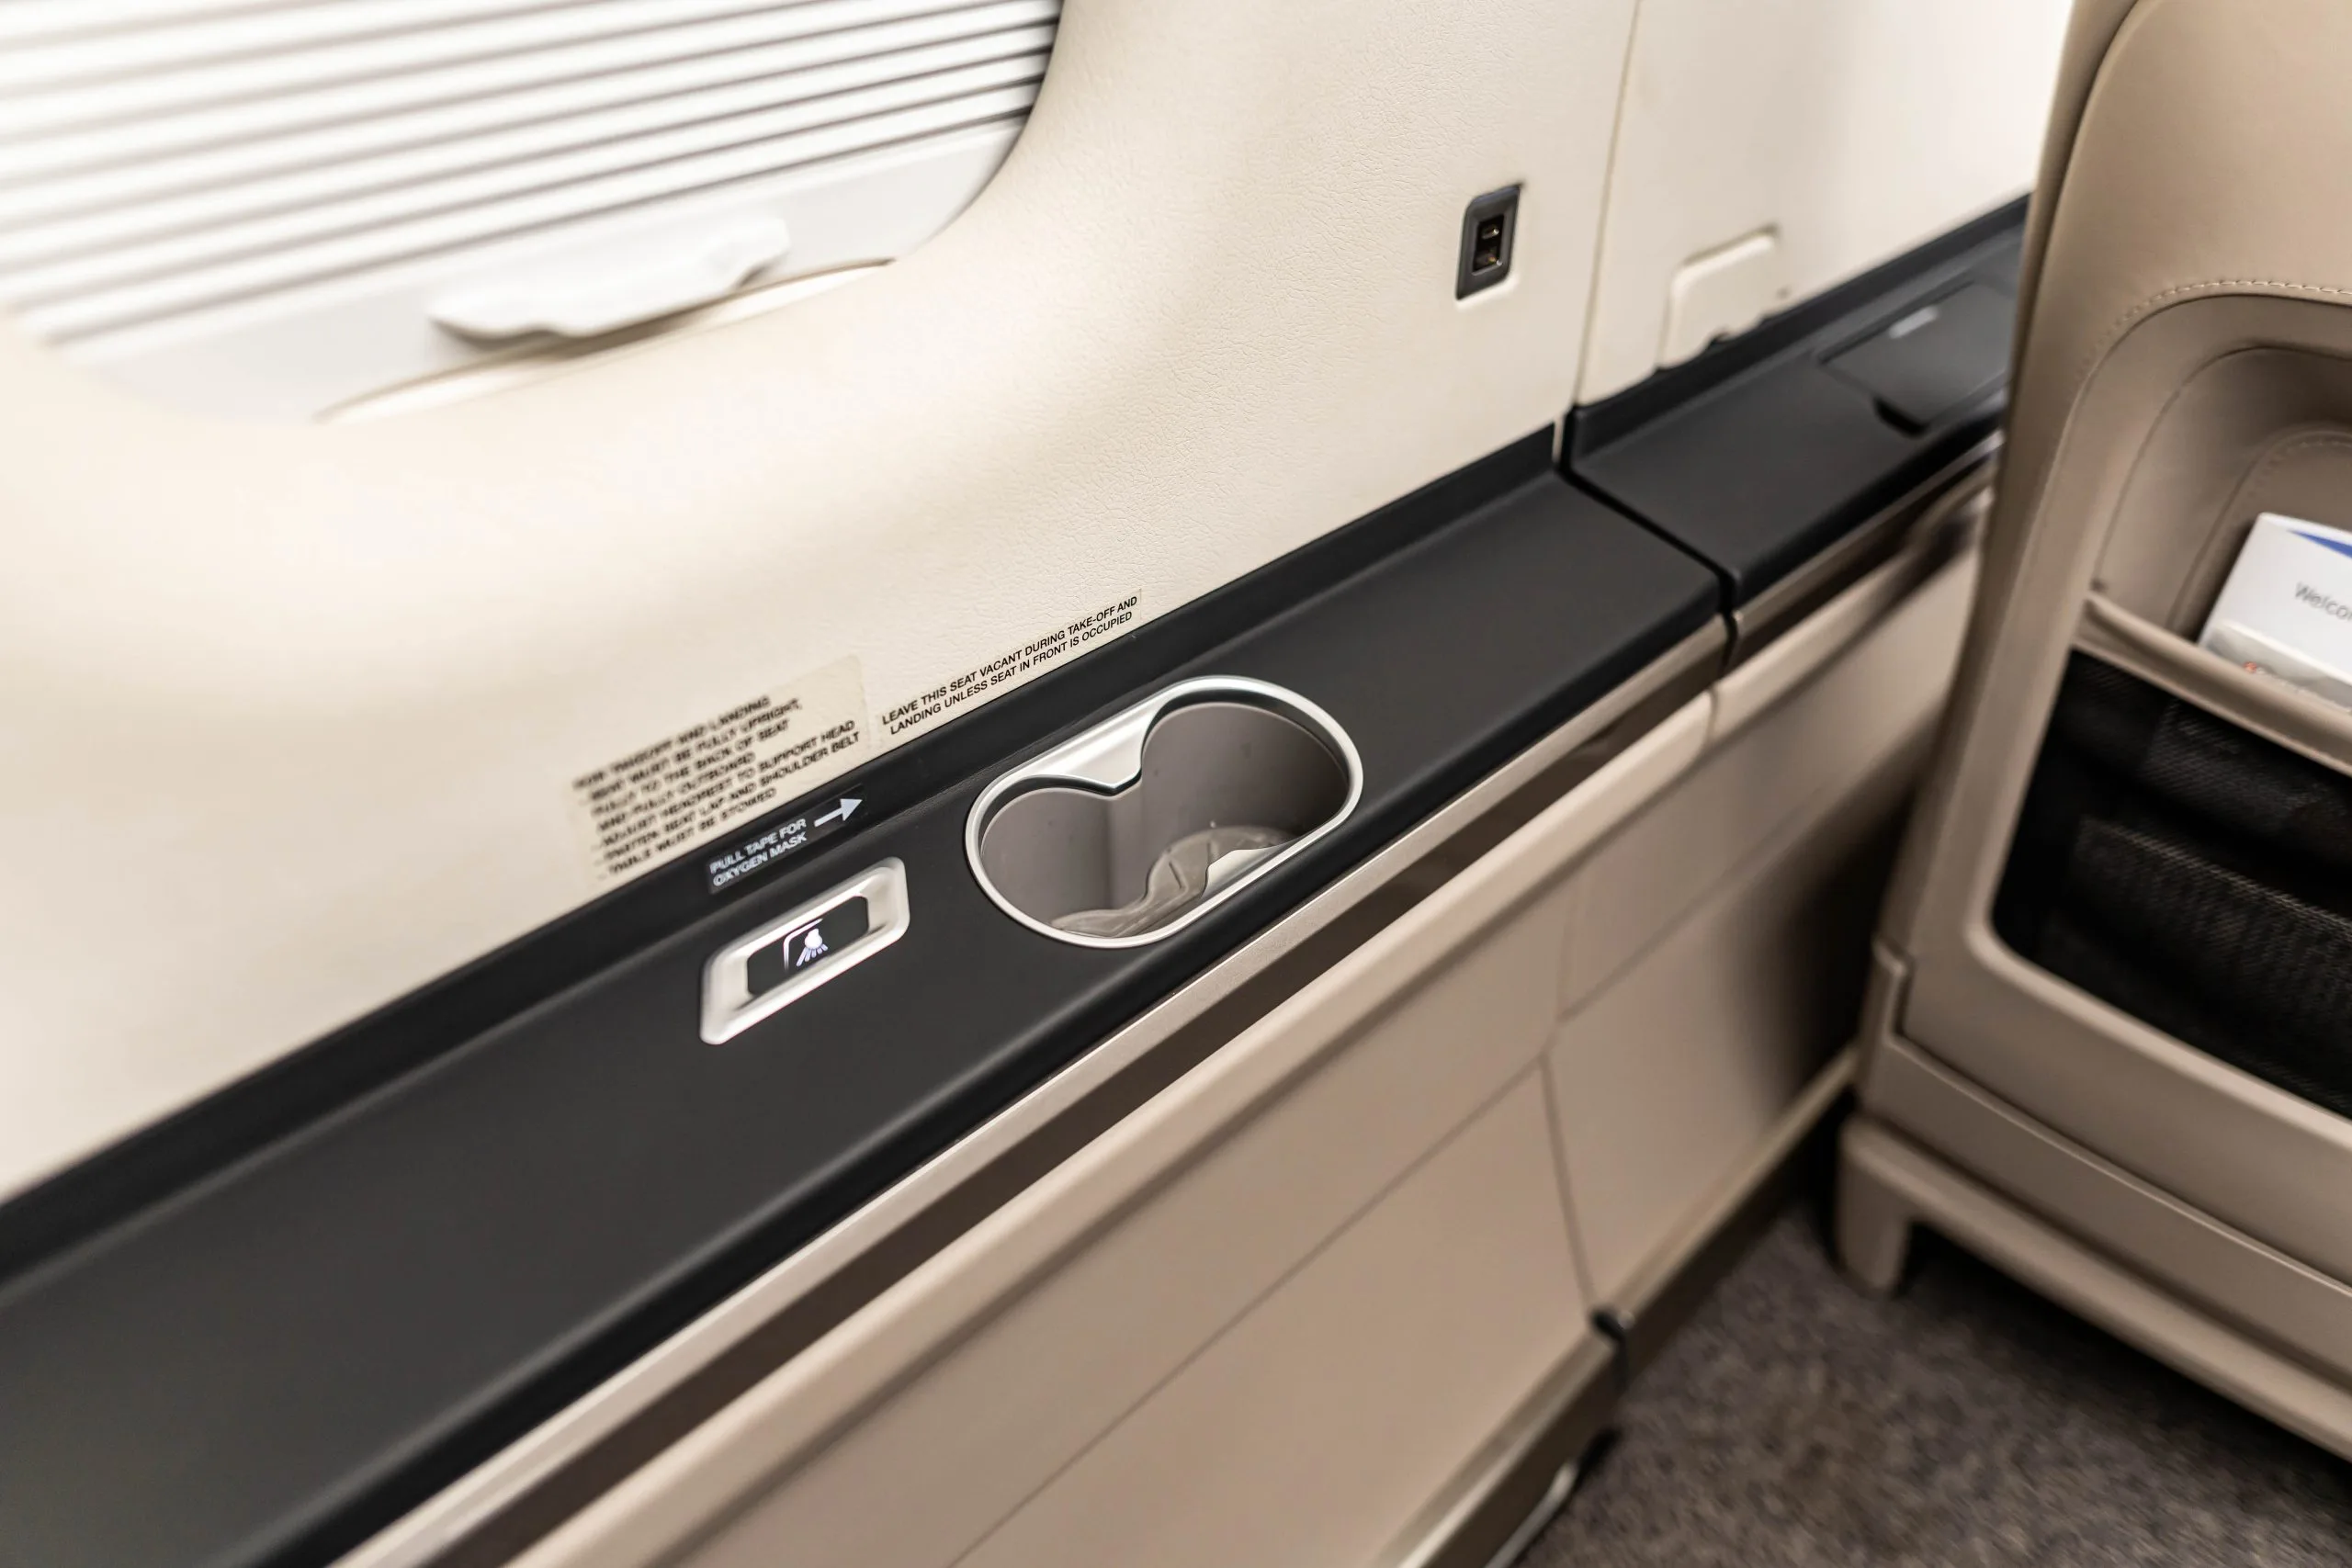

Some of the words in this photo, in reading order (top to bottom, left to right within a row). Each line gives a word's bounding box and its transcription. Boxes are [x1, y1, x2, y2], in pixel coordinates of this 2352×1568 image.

[2295, 581, 2352, 622] Welco
[882, 699, 918, 725] LEAVE
[920, 686, 946, 705] THIS
[949, 671, 977, 692] SEAT
[979, 649, 1022, 676] VACANT
[1024, 629, 1065, 656] DURING
[1067, 605, 1115, 635] TAKE-OFF
[1116, 595, 1136, 613] AND
[889, 703, 941, 735] LANDING
[944, 680, 988, 707] UNLESS
[990, 665, 1016, 685] SEAT
[1019, 659, 1029, 671] IN
[1033, 640, 1067, 665] FRONT
[1069, 636, 1079, 648] IS
[1081, 611, 1132, 640] OCCUPIED
[757, 736, 817, 773] SUPPORT
[820, 719, 855, 742] HEAD
[759, 746, 829, 787] SHOULDER
[830, 730, 859, 753] BELT
[710, 851, 745, 873] PULL
[744, 831, 777, 854] TAPE
[778, 818, 806, 838] FOR
[712, 852, 767, 886] OXYGEN
[769, 831, 807, 857] MASK
